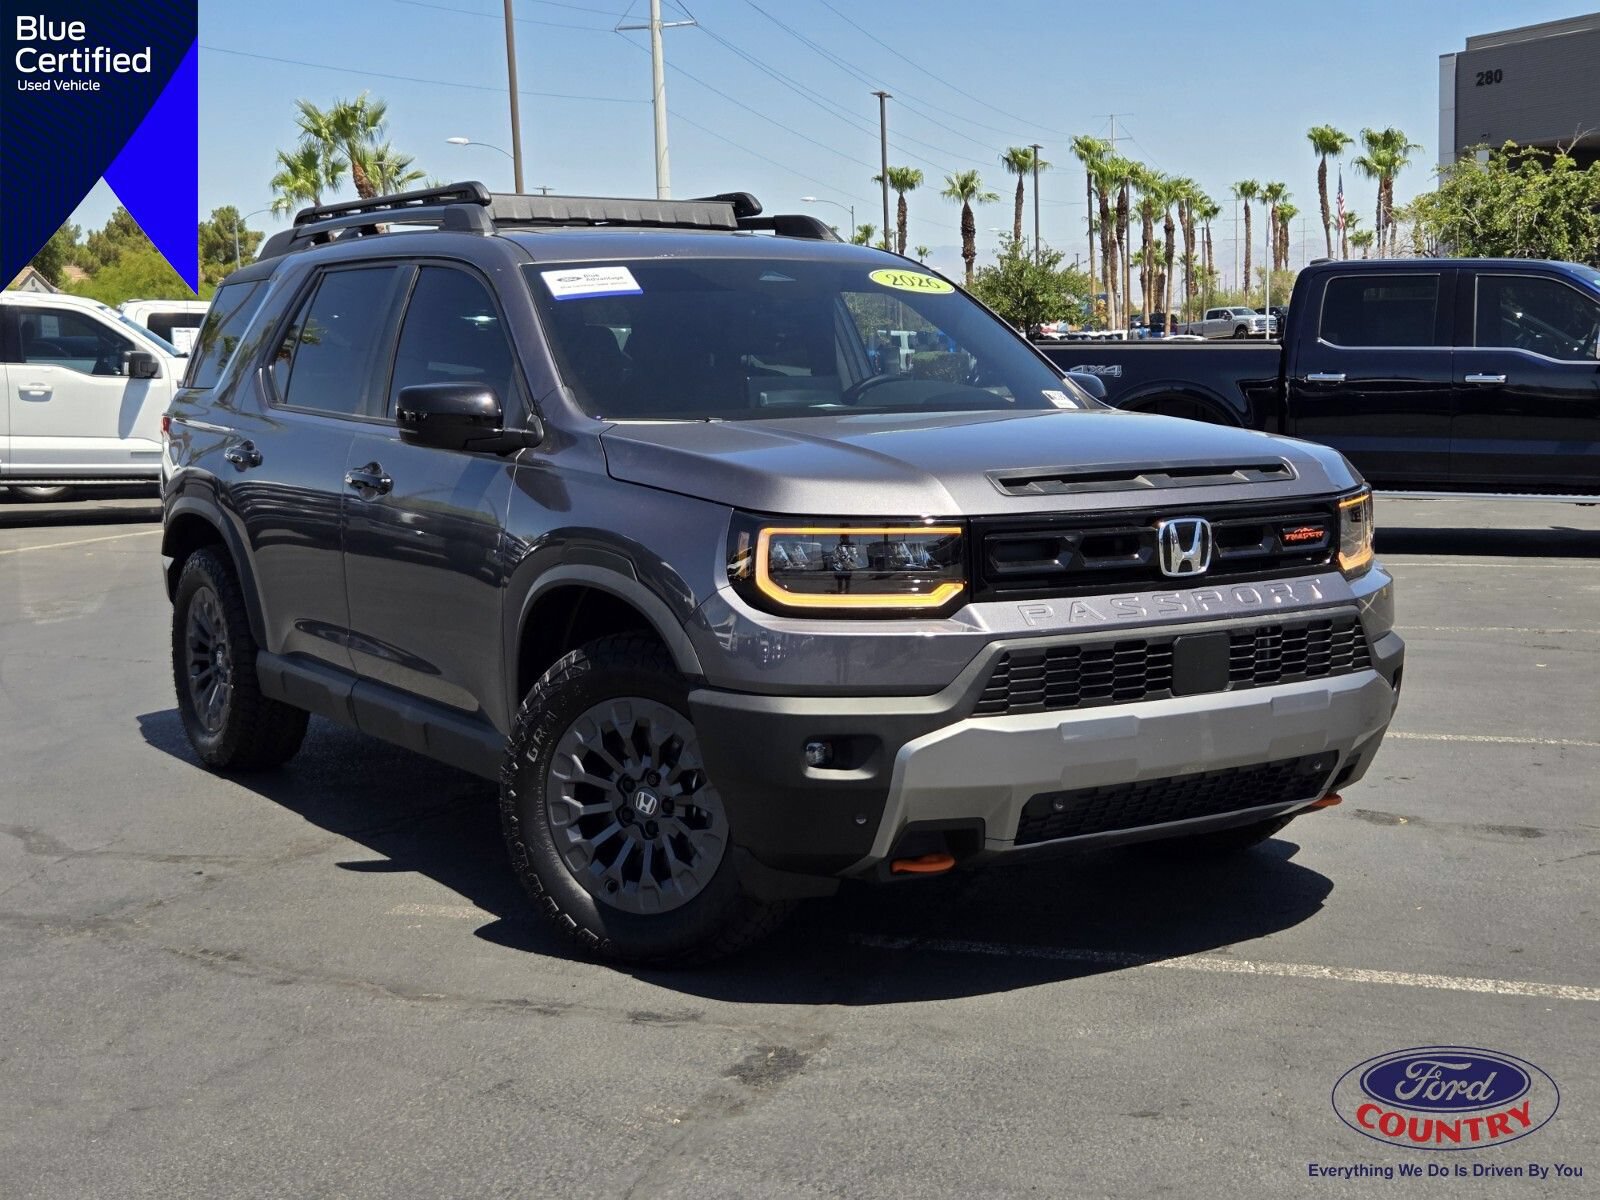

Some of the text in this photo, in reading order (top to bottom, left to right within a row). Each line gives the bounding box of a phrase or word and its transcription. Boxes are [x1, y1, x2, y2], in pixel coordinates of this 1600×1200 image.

[1475, 68, 1503, 87] 280
[886, 273, 941, 289] 2026
[1017, 578, 1323, 627] PASSPORT
